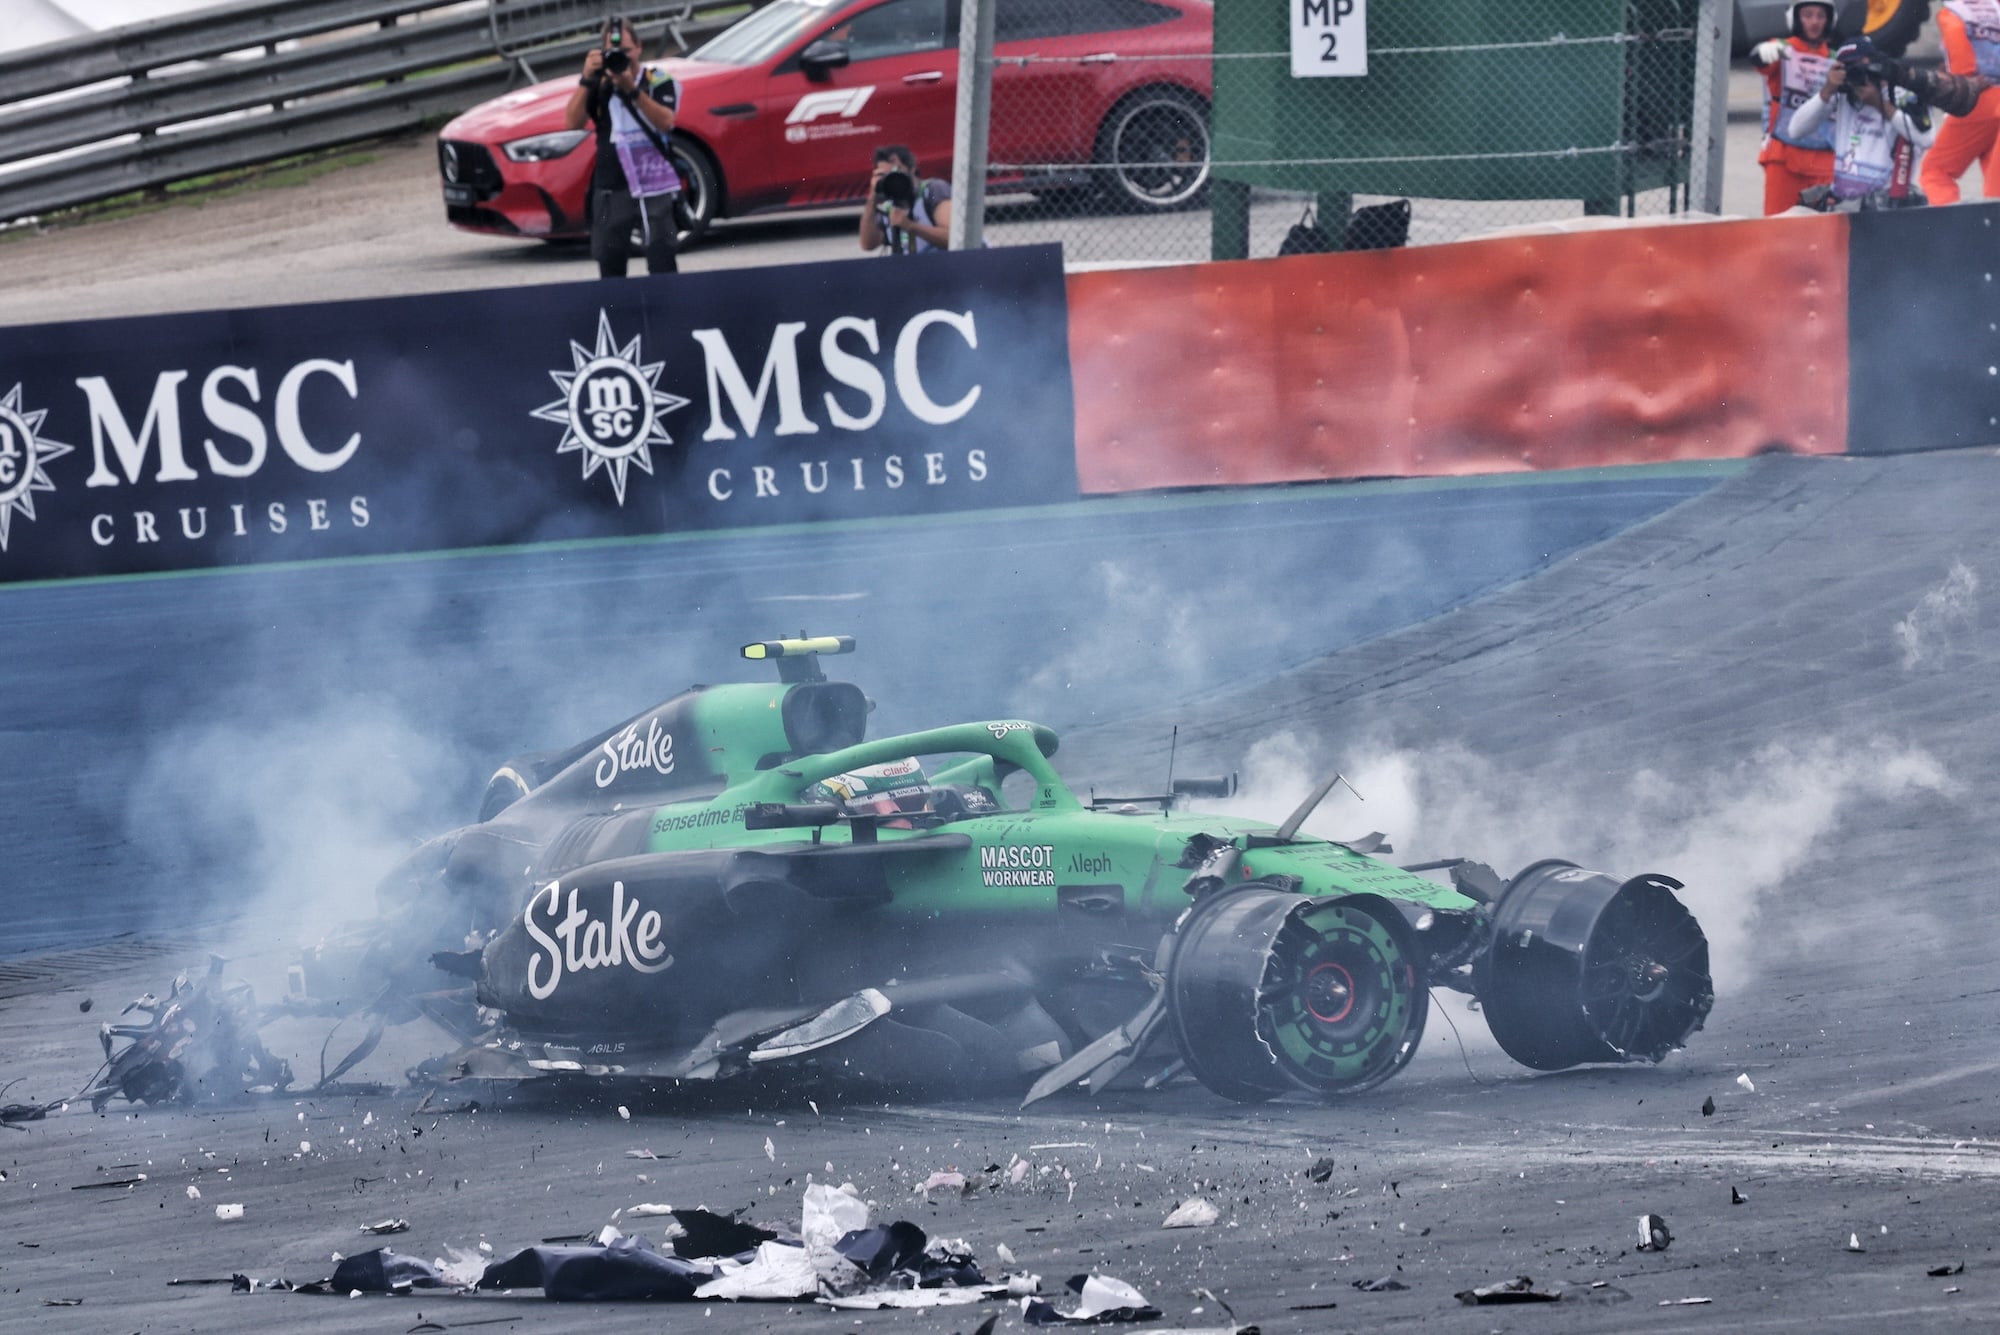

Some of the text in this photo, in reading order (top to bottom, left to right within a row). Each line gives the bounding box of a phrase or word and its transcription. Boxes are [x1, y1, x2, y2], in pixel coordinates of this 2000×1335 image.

[1303, 0, 1353, 26] MP
[1321, 33, 1337, 61] 2
[784, 85, 876, 124] F1
[692, 309, 981, 441] MSC
[75, 358, 362, 488] MSC
[708, 450, 987, 500] CRUISES
[91, 496, 370, 546] CRUISES
[595, 717, 675, 788] Stake
[883, 764, 911, 777] Claro
[653, 808, 731, 834] sensetime
[981, 846, 1053, 868] MASCOT
[1068, 852, 1112, 876] Aleph
[982, 869, 1055, 887] WORKWEAR
[524, 880, 674, 1000] Stake
[587, 1043, 625, 1054] AGILIS
